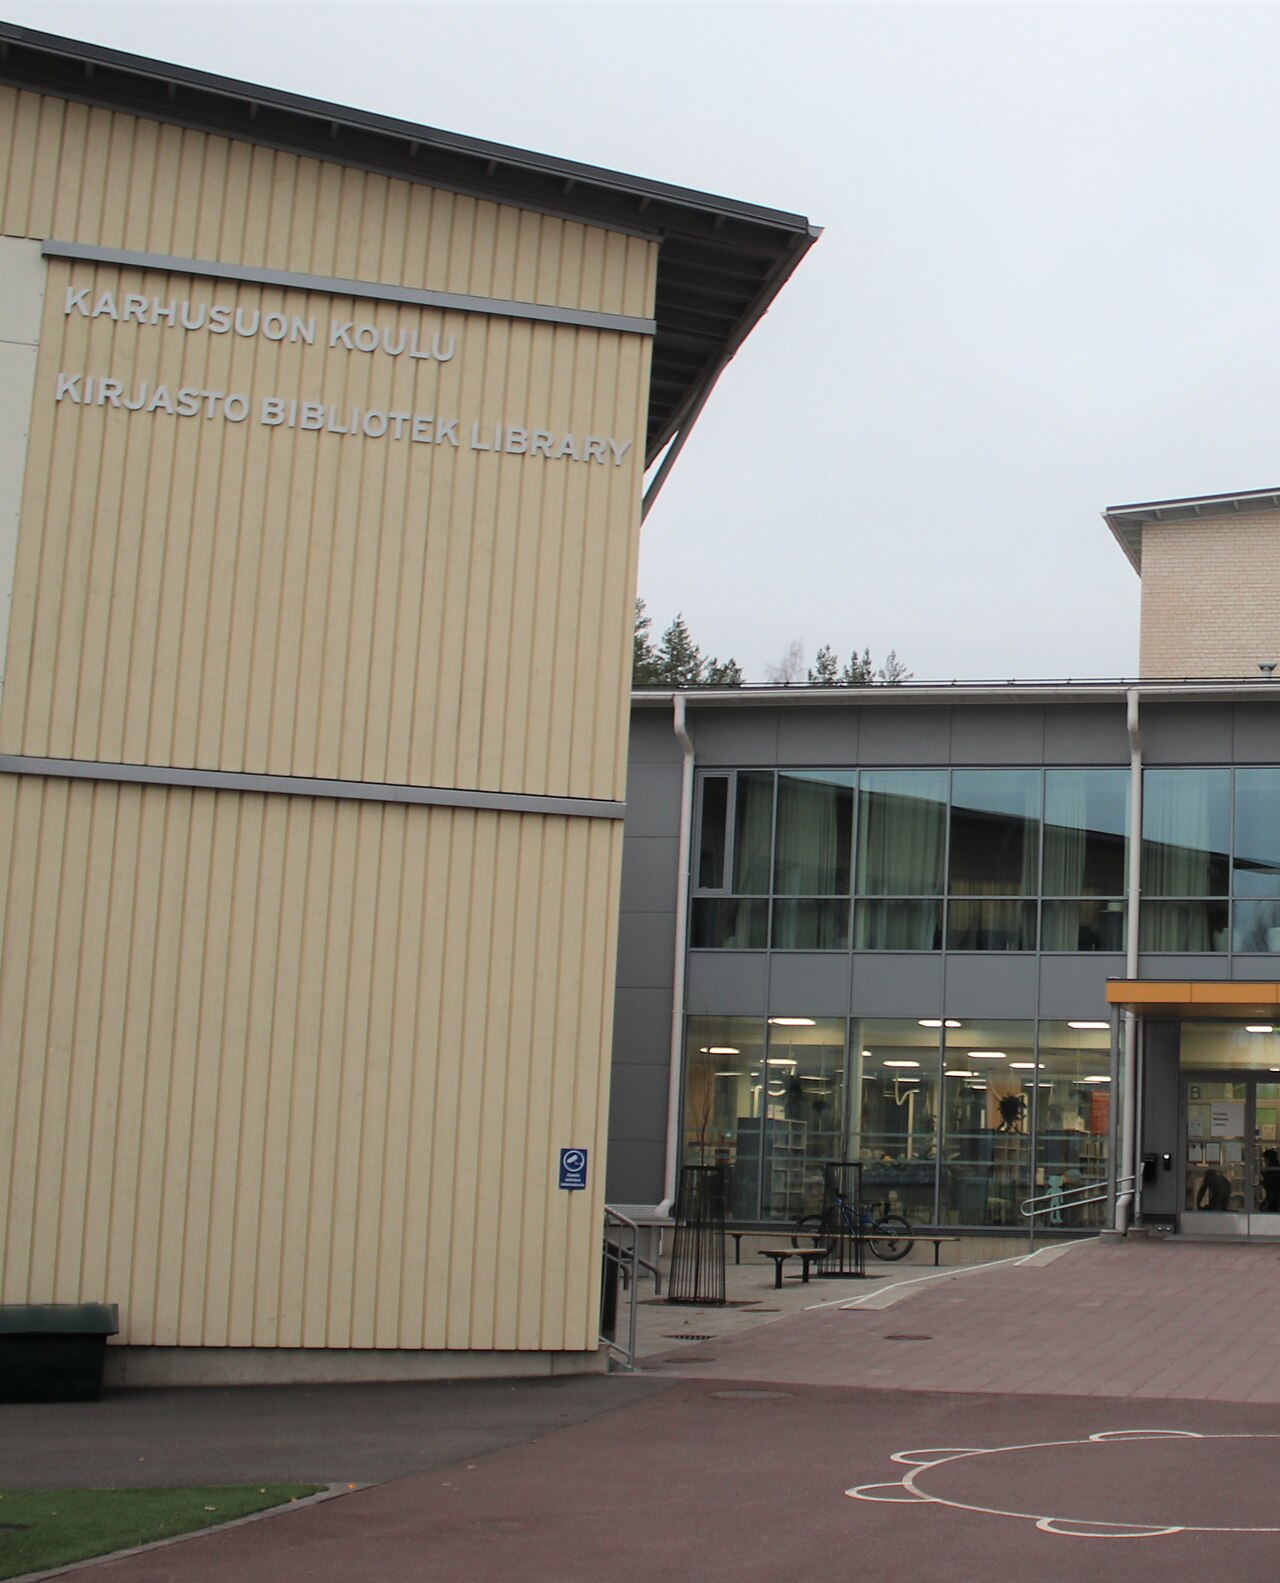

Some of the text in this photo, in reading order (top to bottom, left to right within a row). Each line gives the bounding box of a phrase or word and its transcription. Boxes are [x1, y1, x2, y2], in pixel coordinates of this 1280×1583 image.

[64, 286, 456, 362] KARHUSUON KOULU
[55, 372, 632, 466] KIRJASTO BIBLIOTEK LIBRARY
[1191, 1086, 1201, 1100] B
